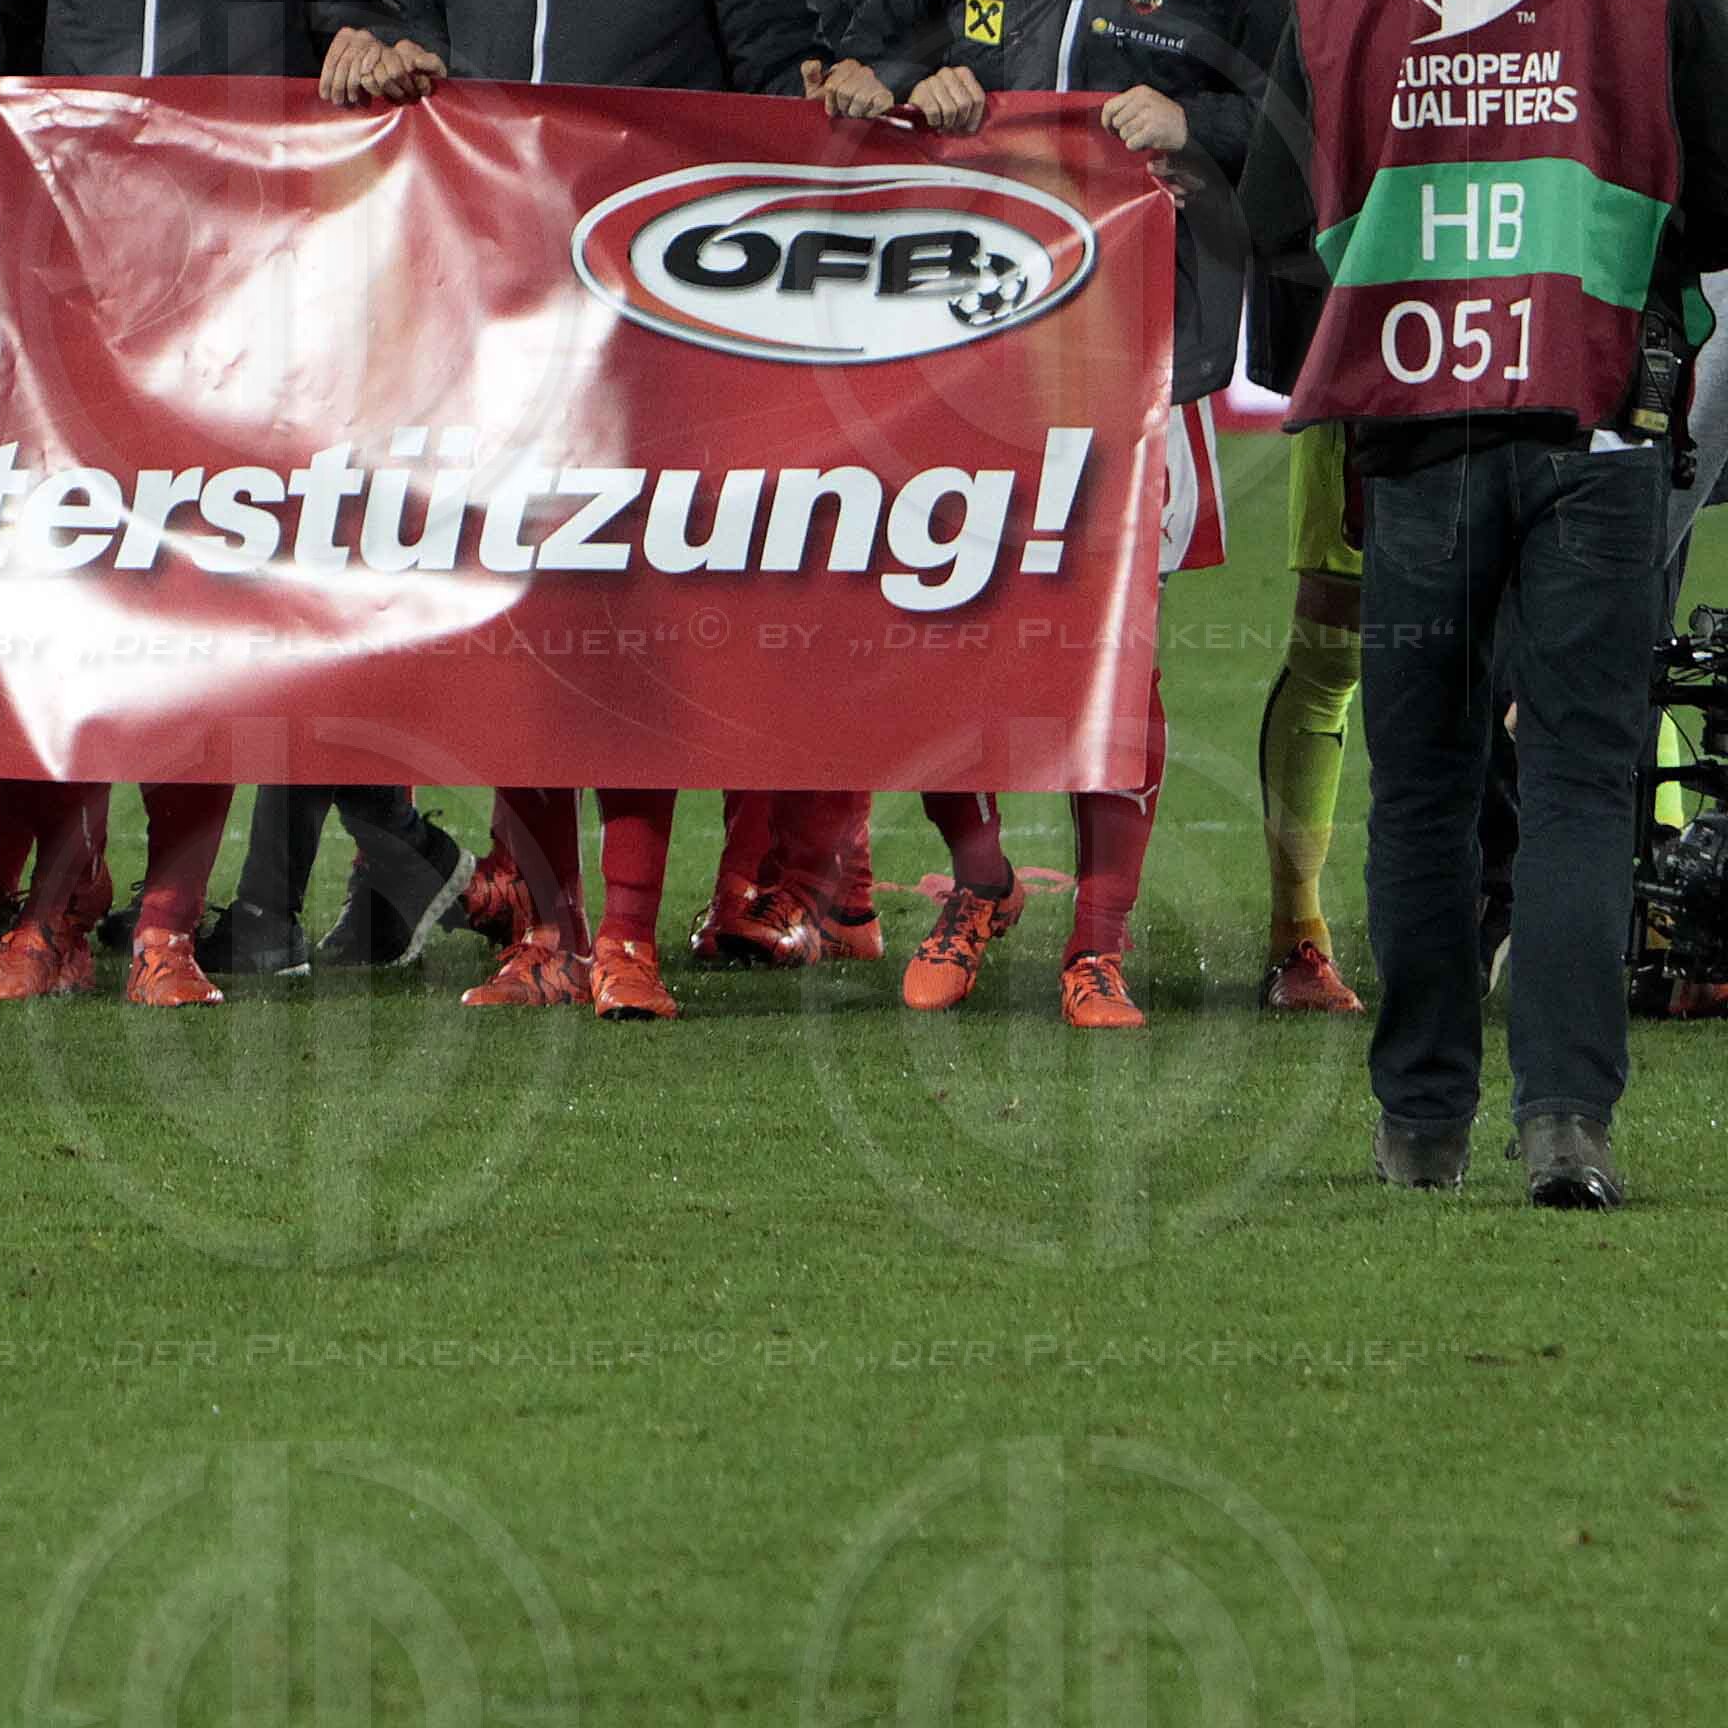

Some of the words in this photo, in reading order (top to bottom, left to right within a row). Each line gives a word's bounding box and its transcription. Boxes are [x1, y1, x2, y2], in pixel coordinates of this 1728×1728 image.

[1396, 50, 1561, 89] UROPEAN
[1391, 85, 1579, 130] UALIFIERS
[1421, 182, 1526, 261] HB
